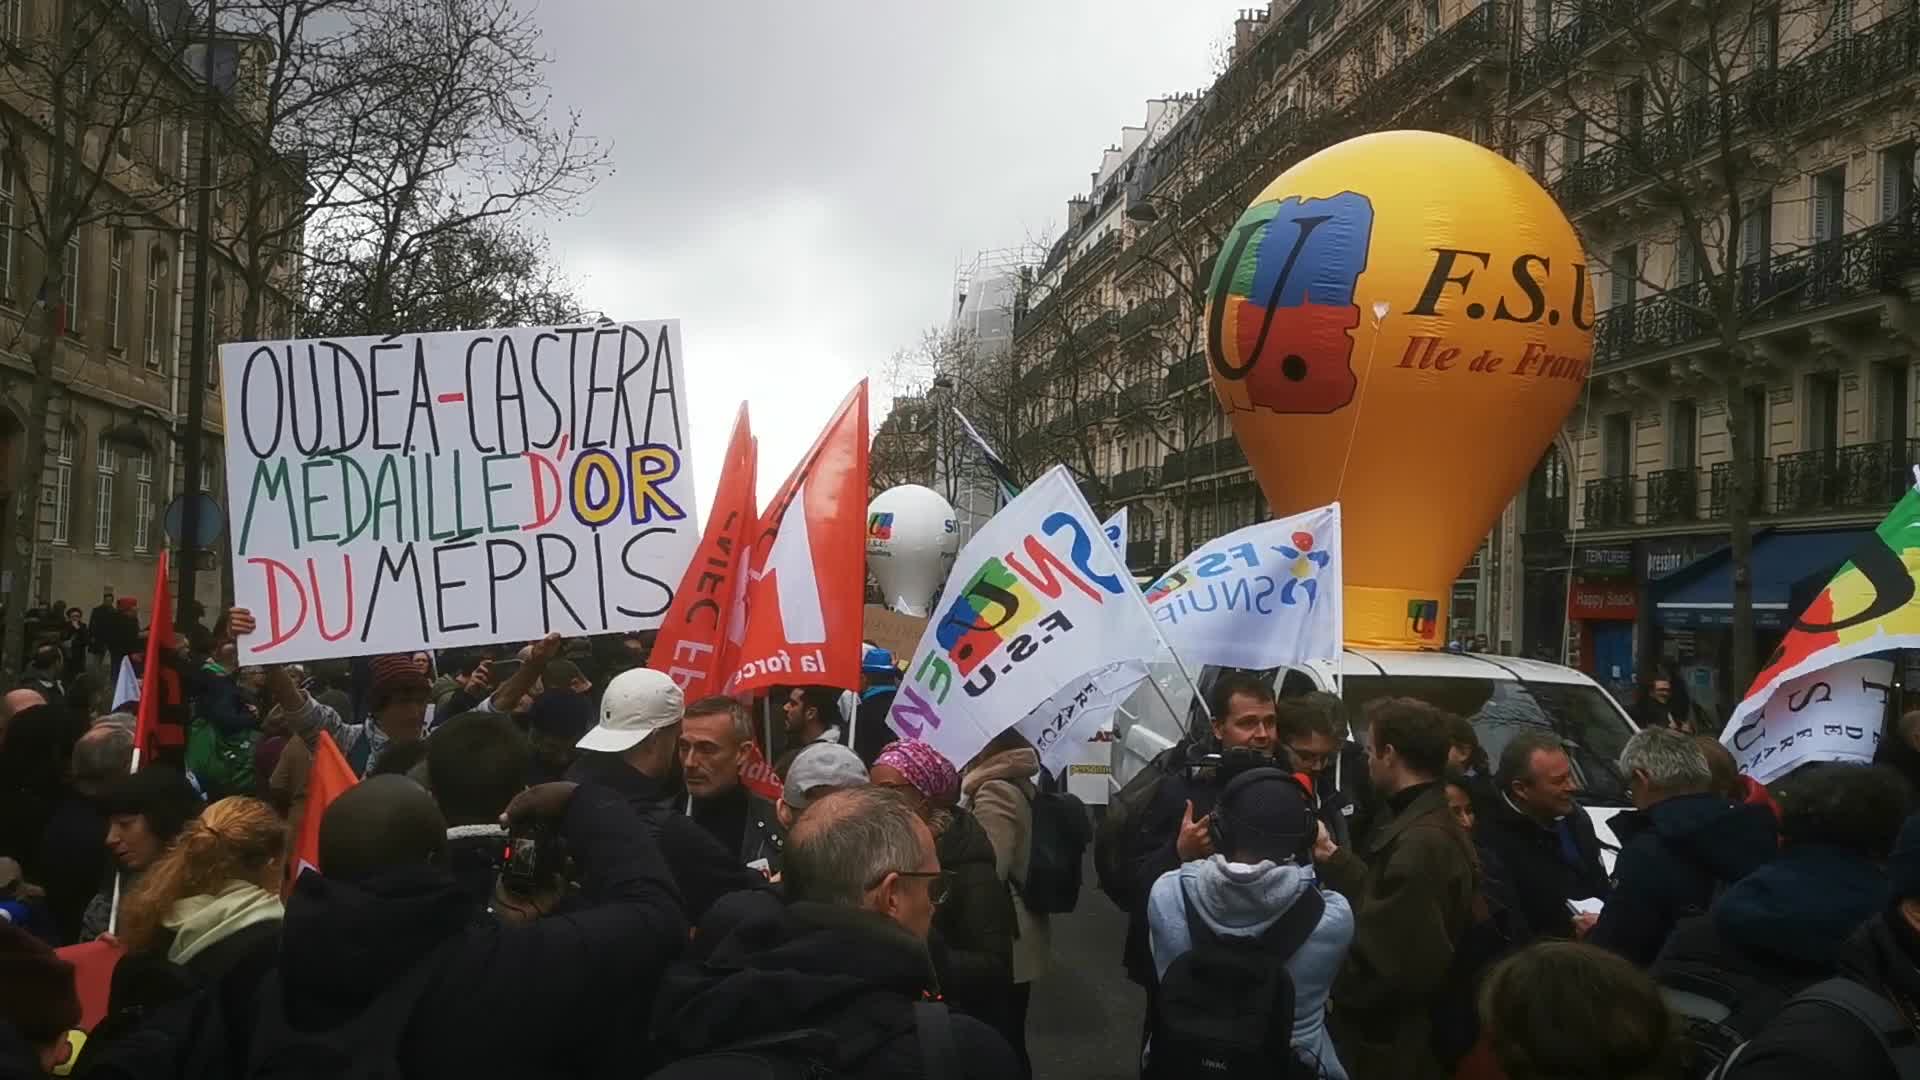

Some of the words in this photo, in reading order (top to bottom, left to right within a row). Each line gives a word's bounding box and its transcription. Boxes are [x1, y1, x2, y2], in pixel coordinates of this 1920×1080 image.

[1394, 335, 1461, 371] Ile
[1468, 350, 1504, 373] de
[238, 445, 521, 555] MÉDAILLE
[248, 554, 354, 652] DU
[361, 526, 676, 642] MÉPRIS
